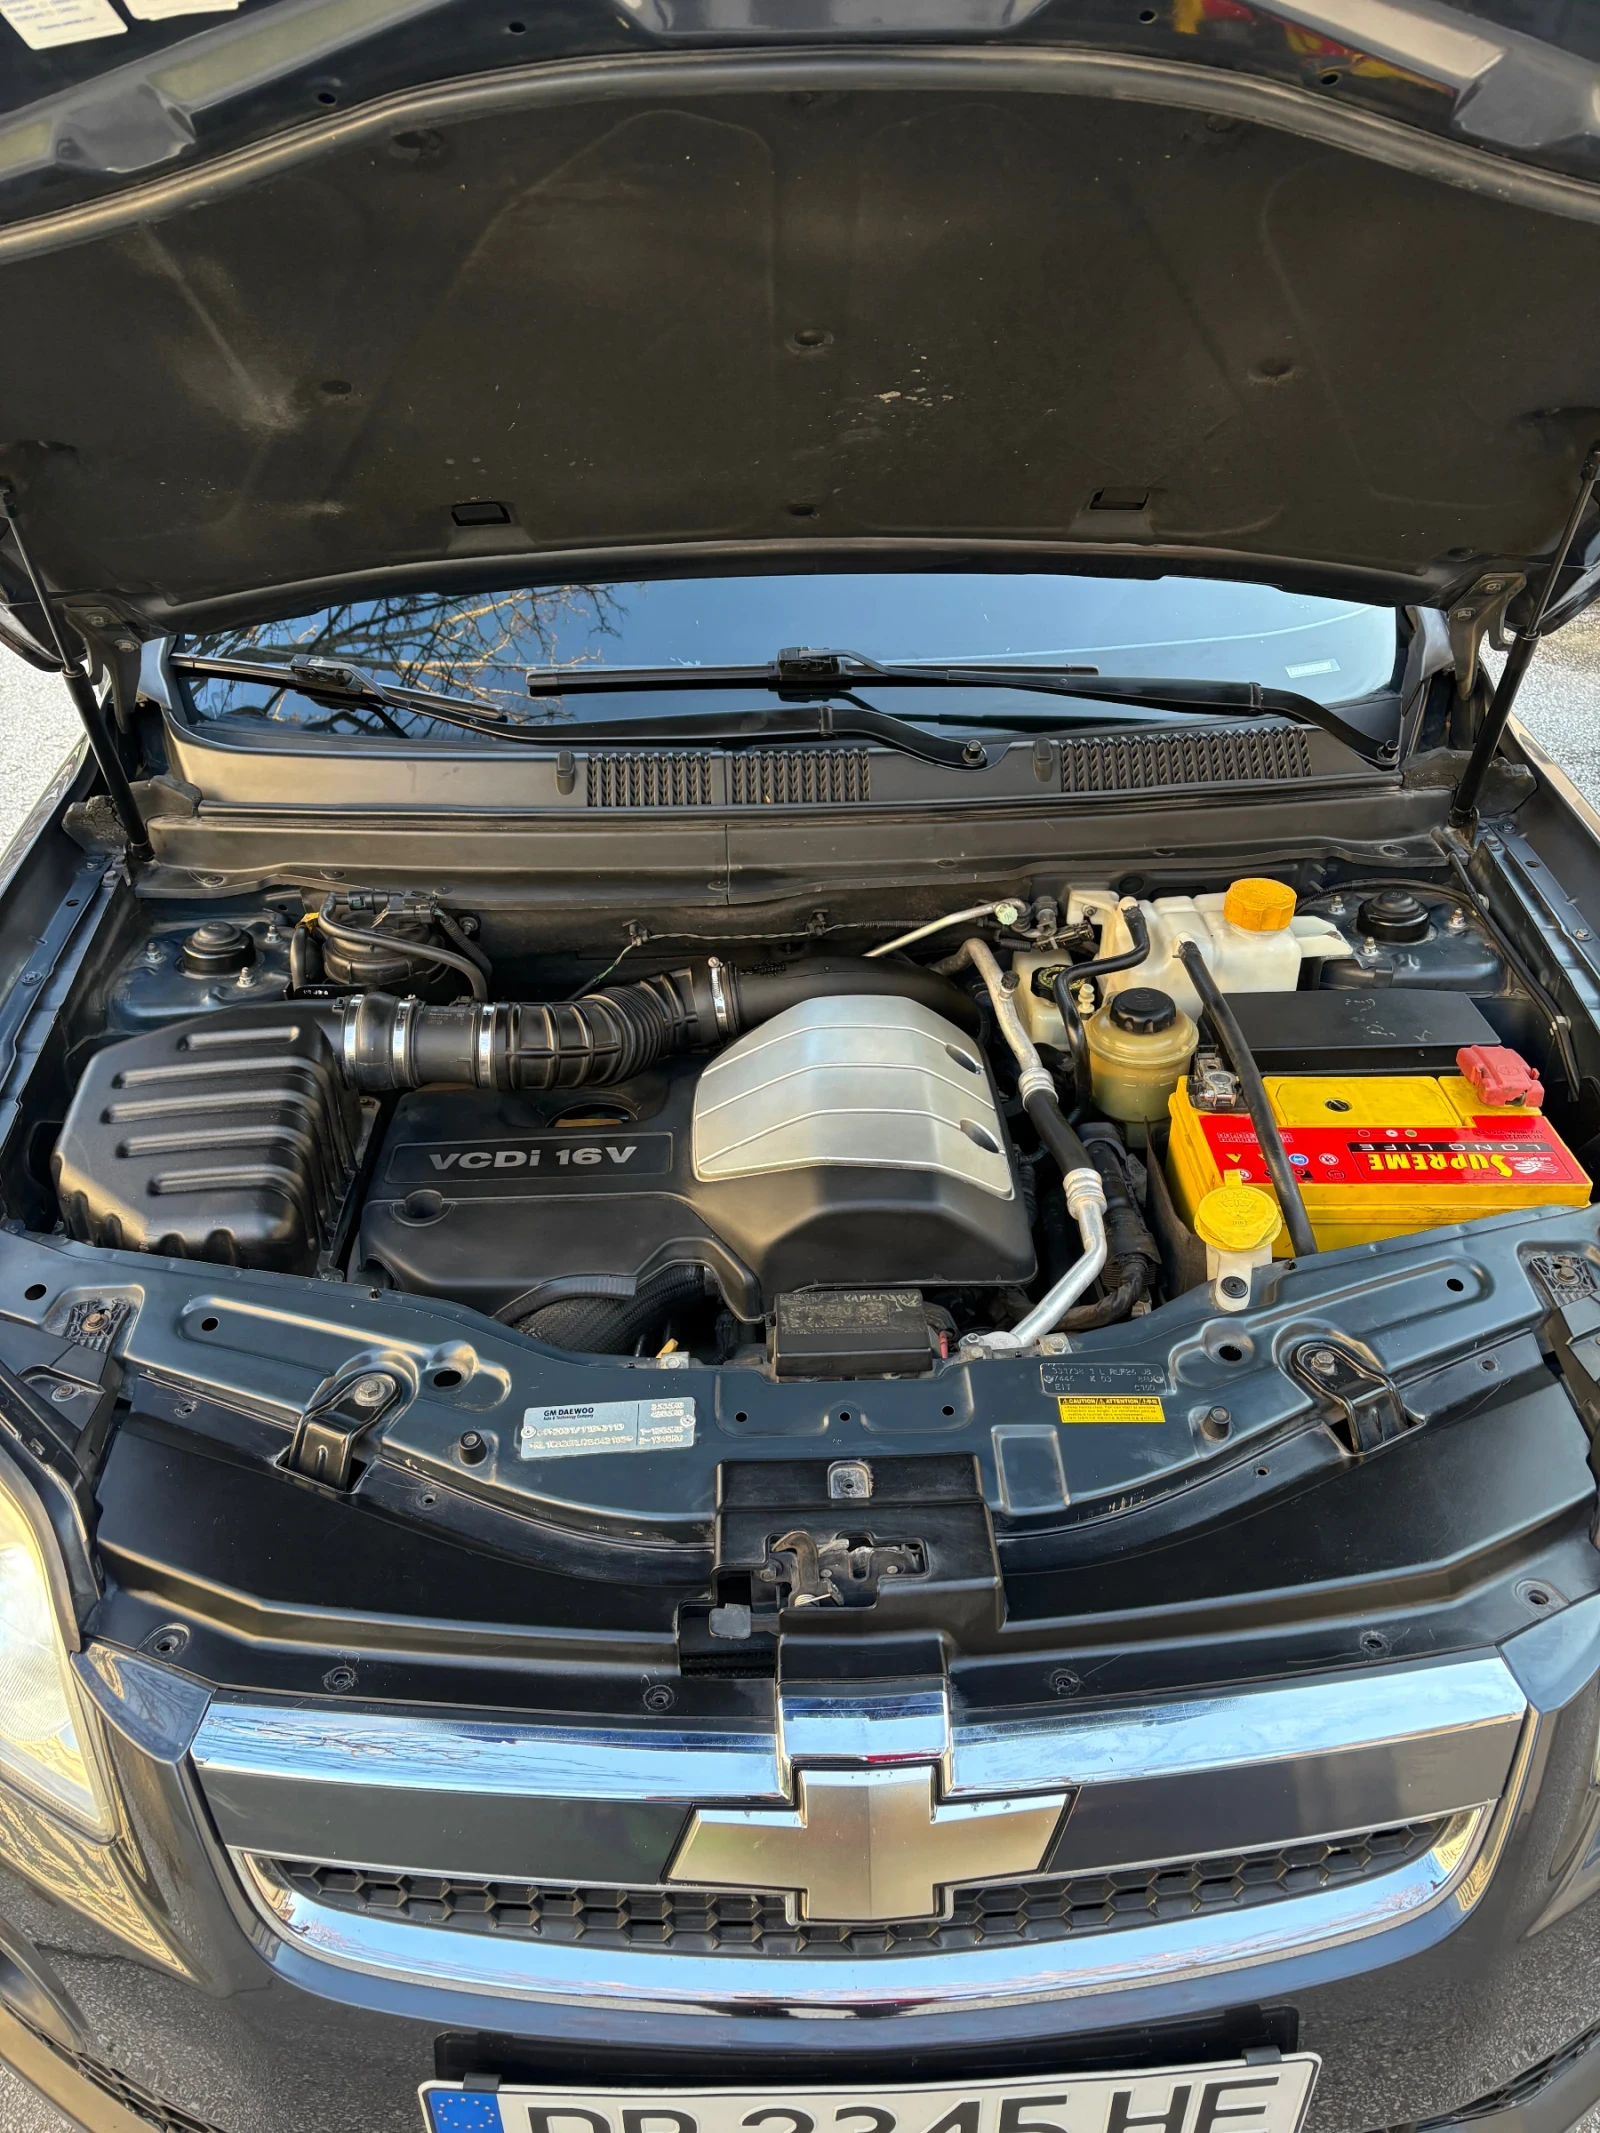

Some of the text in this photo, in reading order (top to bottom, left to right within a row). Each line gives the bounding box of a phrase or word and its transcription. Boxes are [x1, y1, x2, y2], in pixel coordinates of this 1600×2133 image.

[1359, 1143, 1541, 1151] LONG LIFE
[429, 1146, 637, 1171] VCDi 16V
[1367, 1153, 1512, 1178] SUPREME
[543, 1407, 594, 1417] GM DAEWOO
